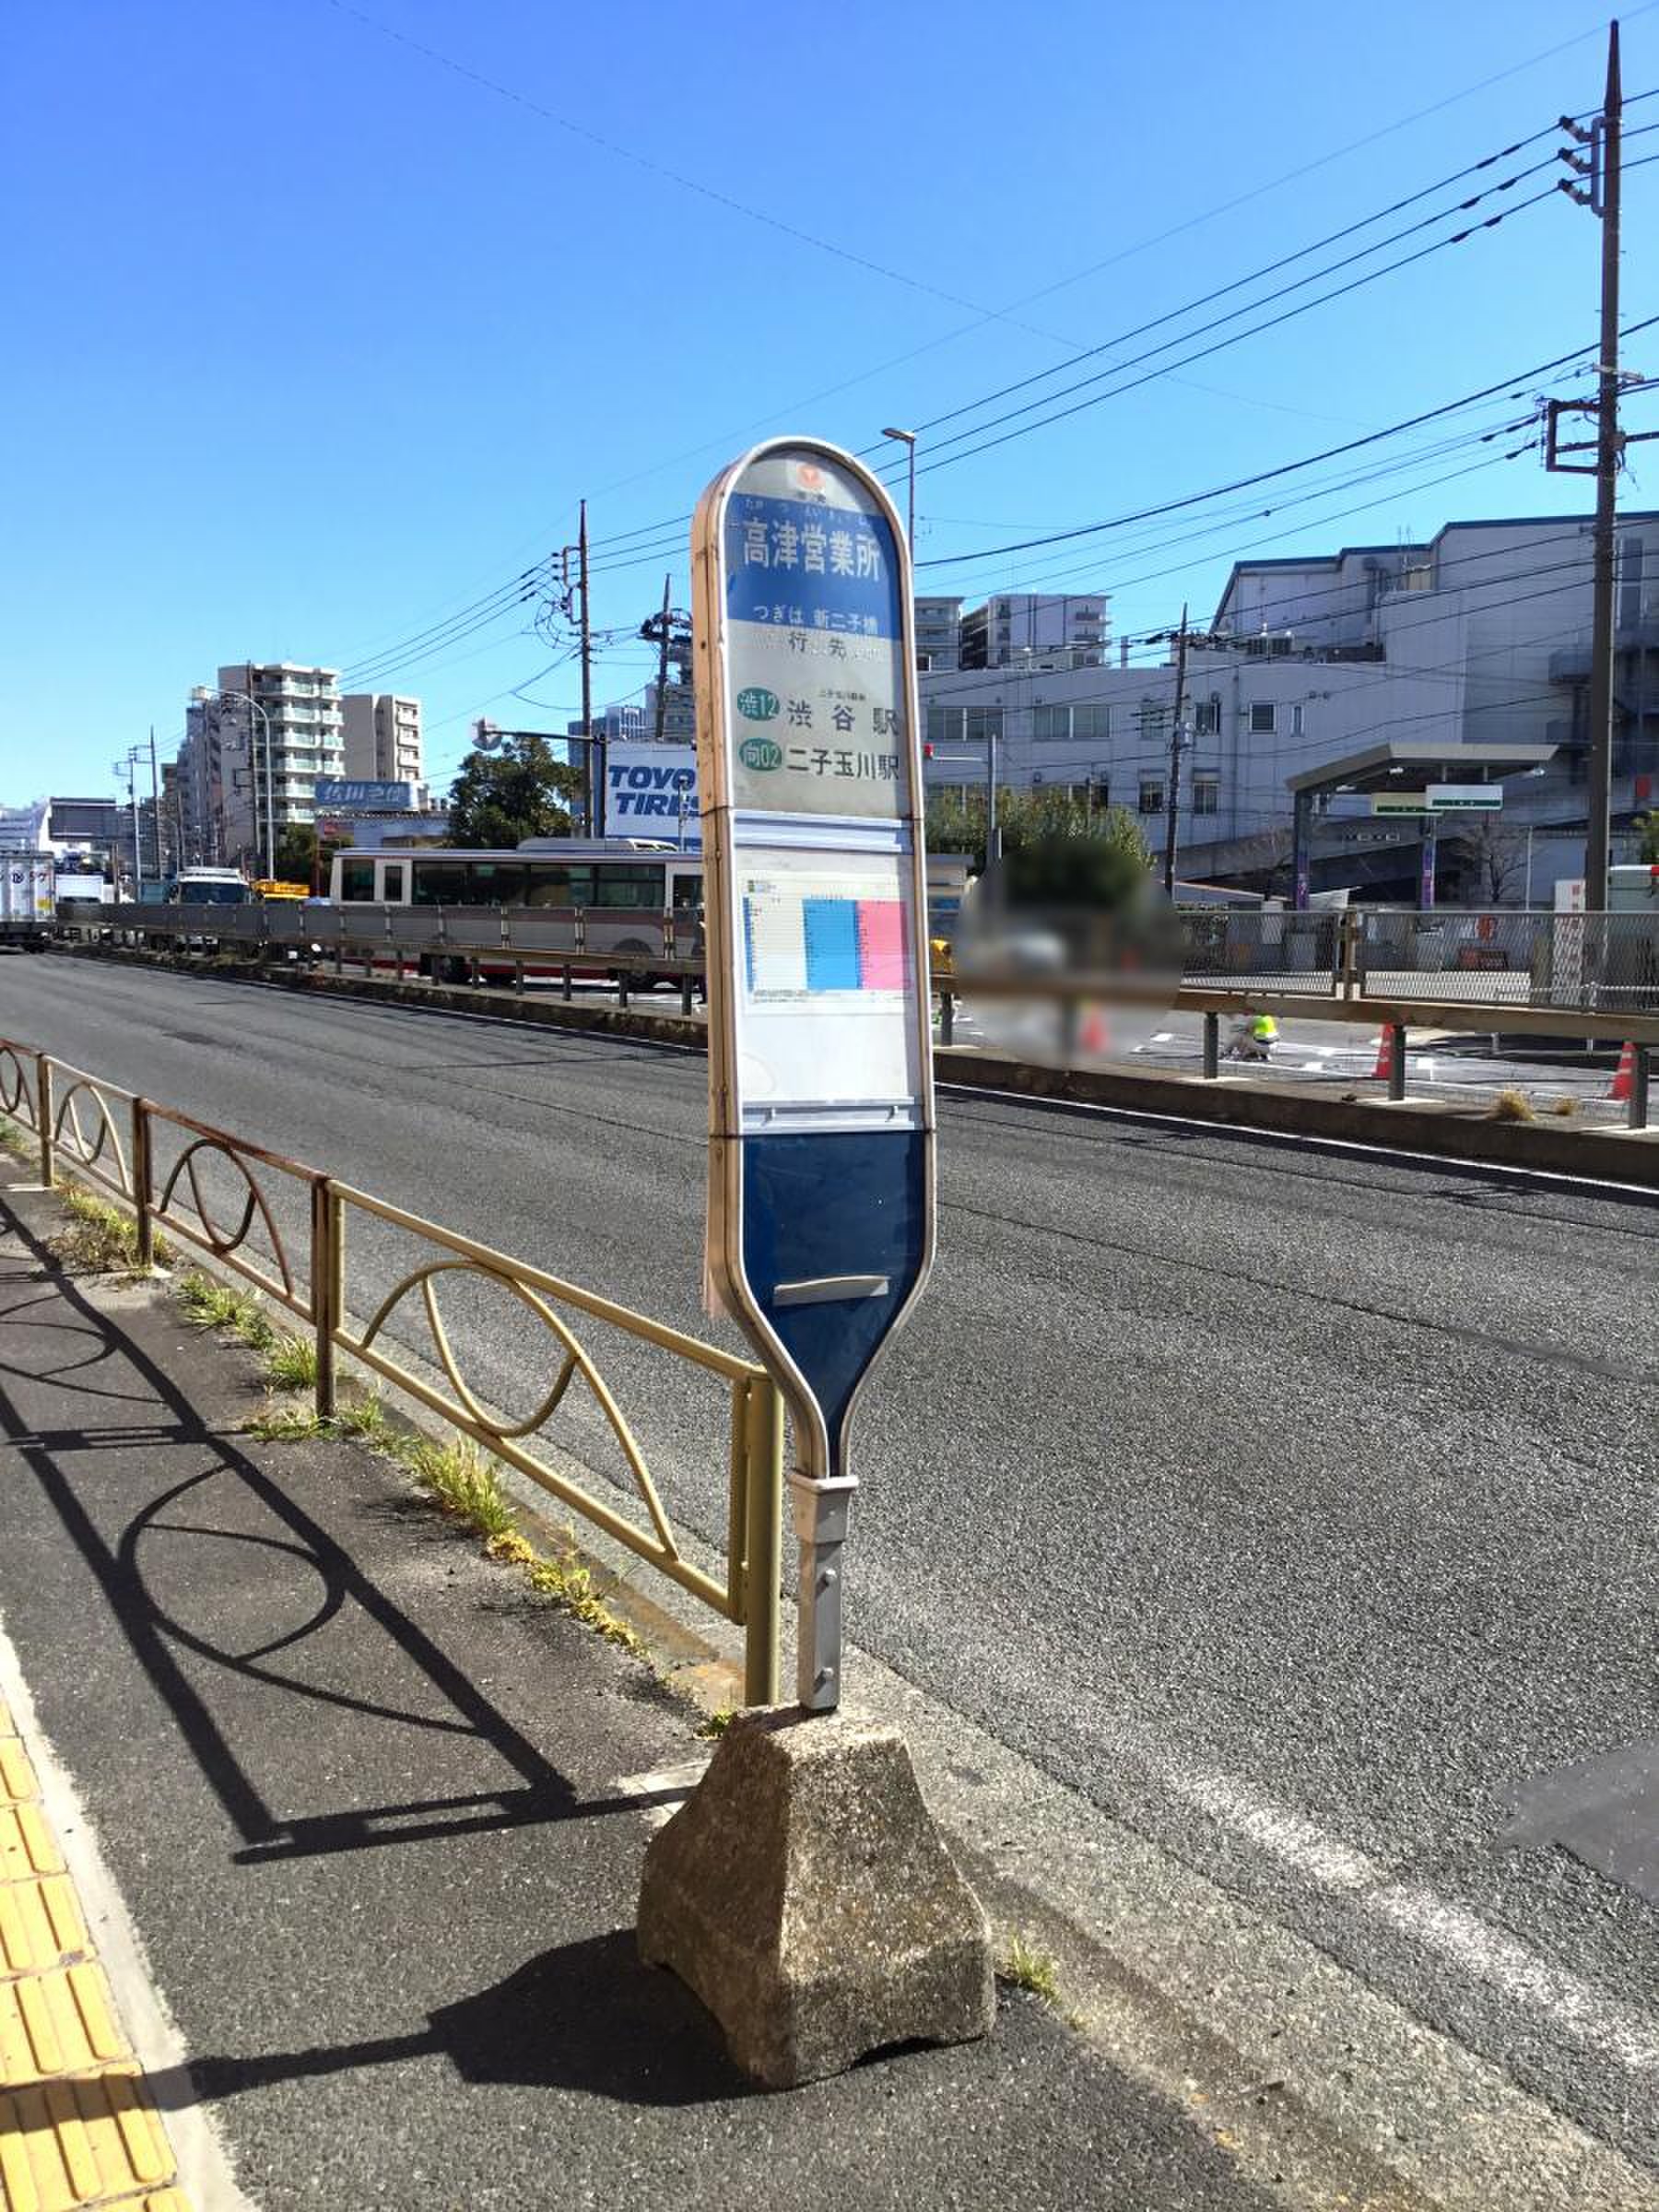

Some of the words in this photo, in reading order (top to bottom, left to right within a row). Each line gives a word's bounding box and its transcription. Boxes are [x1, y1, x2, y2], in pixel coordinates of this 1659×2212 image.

[742, 516, 881, 582] 高津営業所
[753, 604, 804, 625] つぎは
[738, 690, 778, 717] 渋12
[786, 747, 900, 781] 二子玉川駅
[608, 765, 697, 791] TOYO
